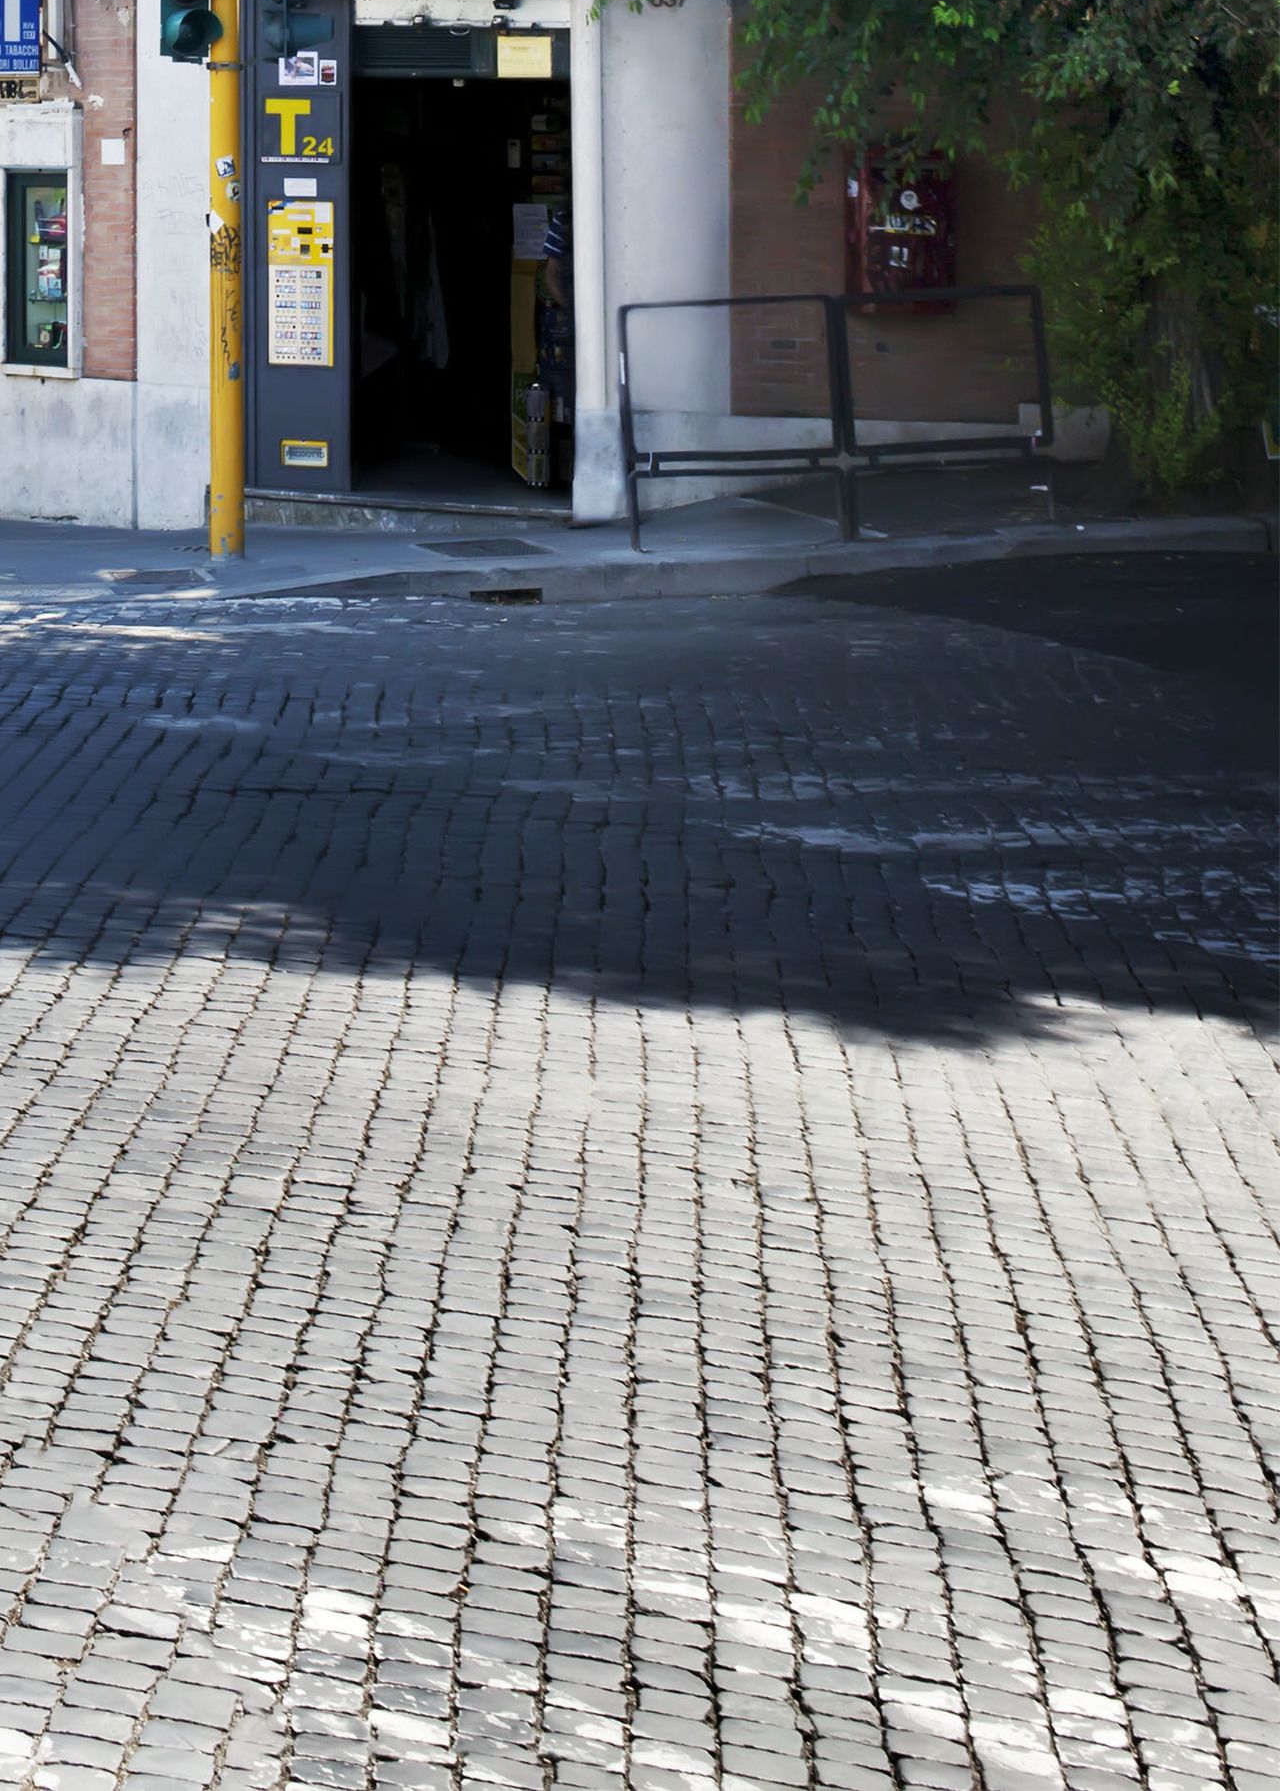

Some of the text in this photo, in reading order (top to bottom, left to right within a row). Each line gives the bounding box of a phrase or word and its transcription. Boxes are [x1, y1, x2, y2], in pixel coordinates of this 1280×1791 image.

[5, 45, 39, 56] TABACCHI
[13, 59, 39, 70] BOLLATI
[265, 98, 334, 156] T 24
